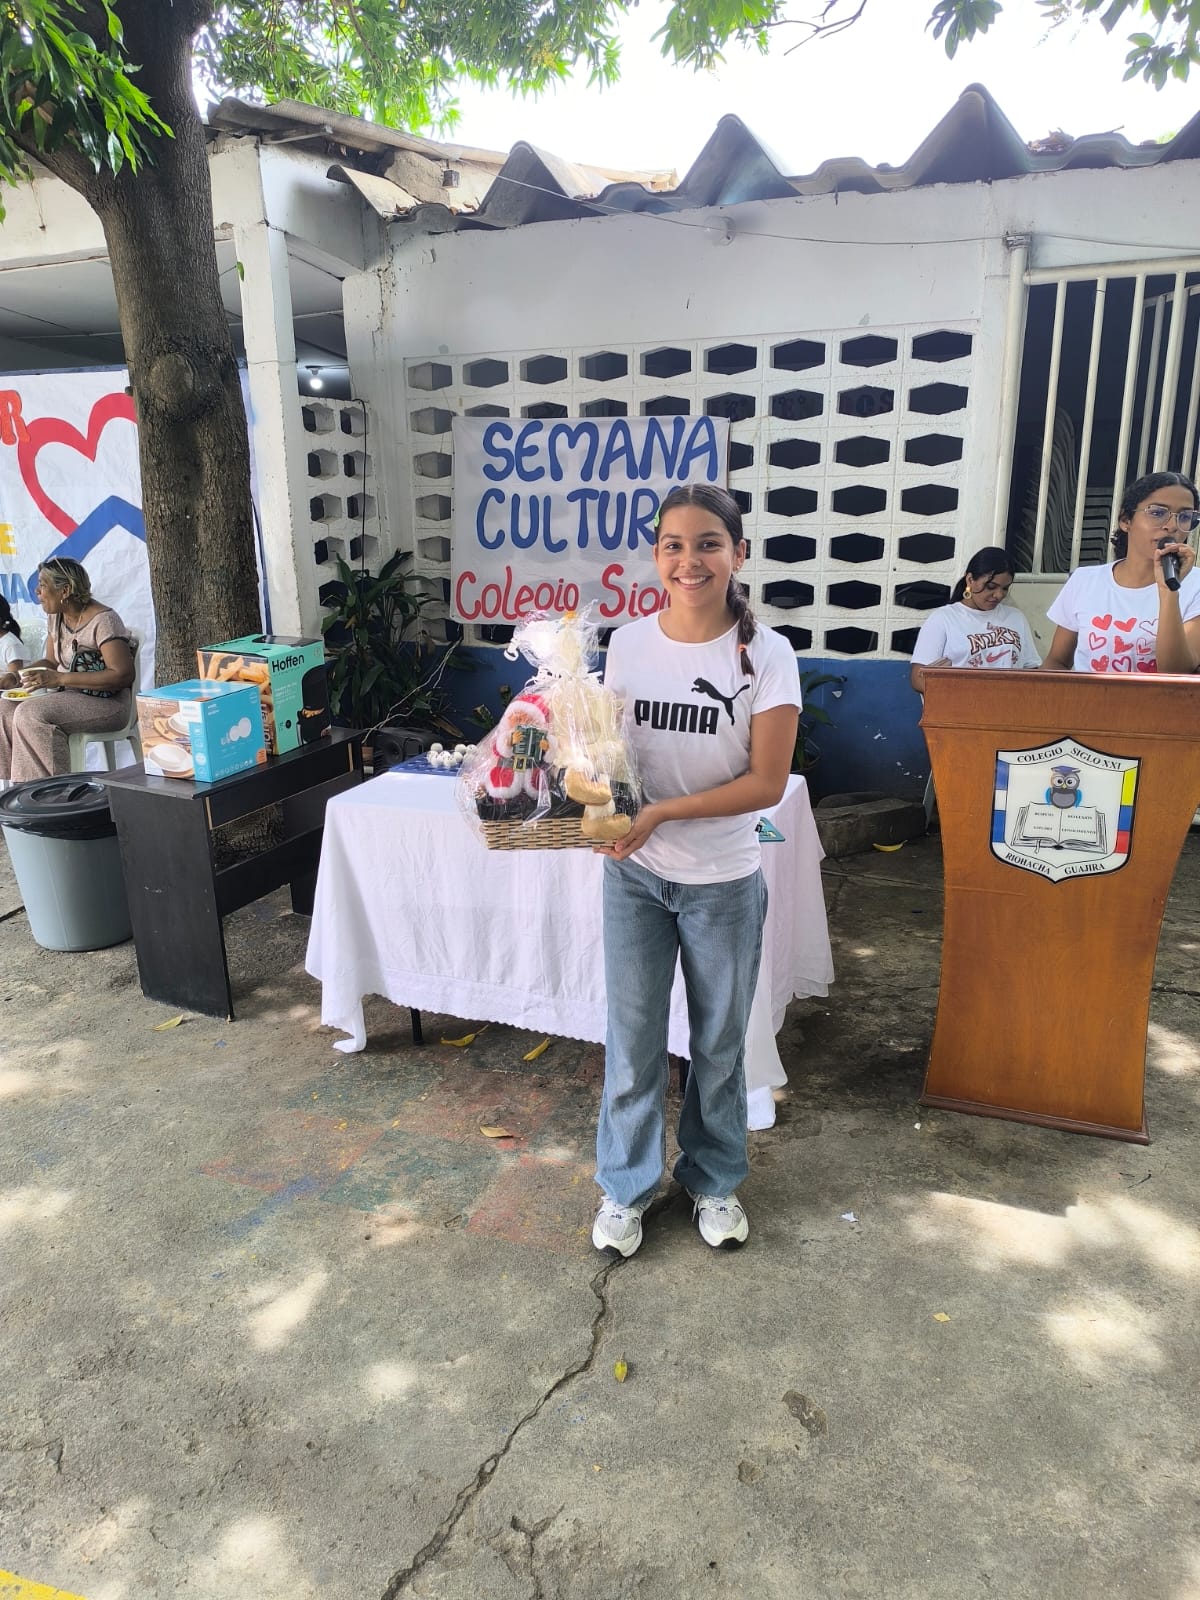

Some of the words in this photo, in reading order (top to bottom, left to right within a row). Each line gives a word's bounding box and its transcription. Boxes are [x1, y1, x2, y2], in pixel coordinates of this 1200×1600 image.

[482, 416, 718, 482] SEMANA
[476, 485, 682, 553] CULTUR
[967, 626, 1021, 655] NIKE
[272, 654, 304, 673] Hoffen
[634, 699, 719, 735] PUMA
[1017, 747, 1063, 763] COLEGIO
[1071, 747, 1100, 765] SIGLO
[1102, 759, 1121, 770] XXI
[1005, 852, 1050, 875] RIOHACHA
[1064, 863, 1105, 875] GUAJIRA
